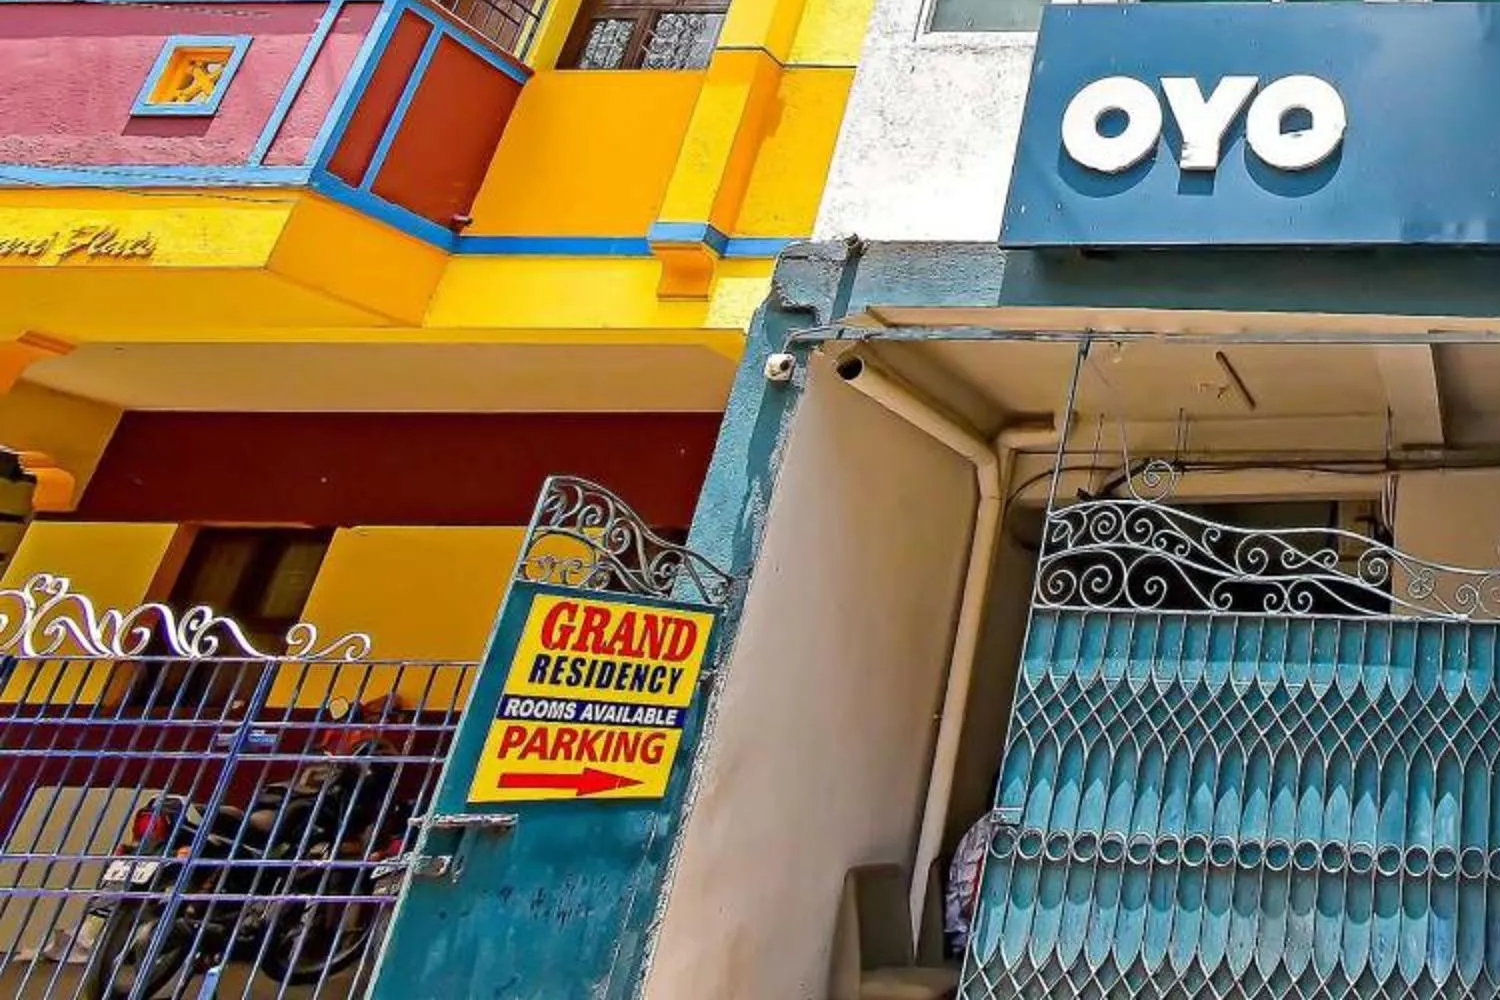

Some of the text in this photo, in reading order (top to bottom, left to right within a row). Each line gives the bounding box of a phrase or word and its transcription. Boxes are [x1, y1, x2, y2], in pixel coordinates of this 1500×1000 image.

[1061, 73, 1347, 174] OYO
[540, 601, 698, 663] GRAND
[528, 653, 685, 696] RESIDENCY
[504, 698, 678, 726] ROOMS AVAILABLE
[497, 726, 668, 765] PARKING
